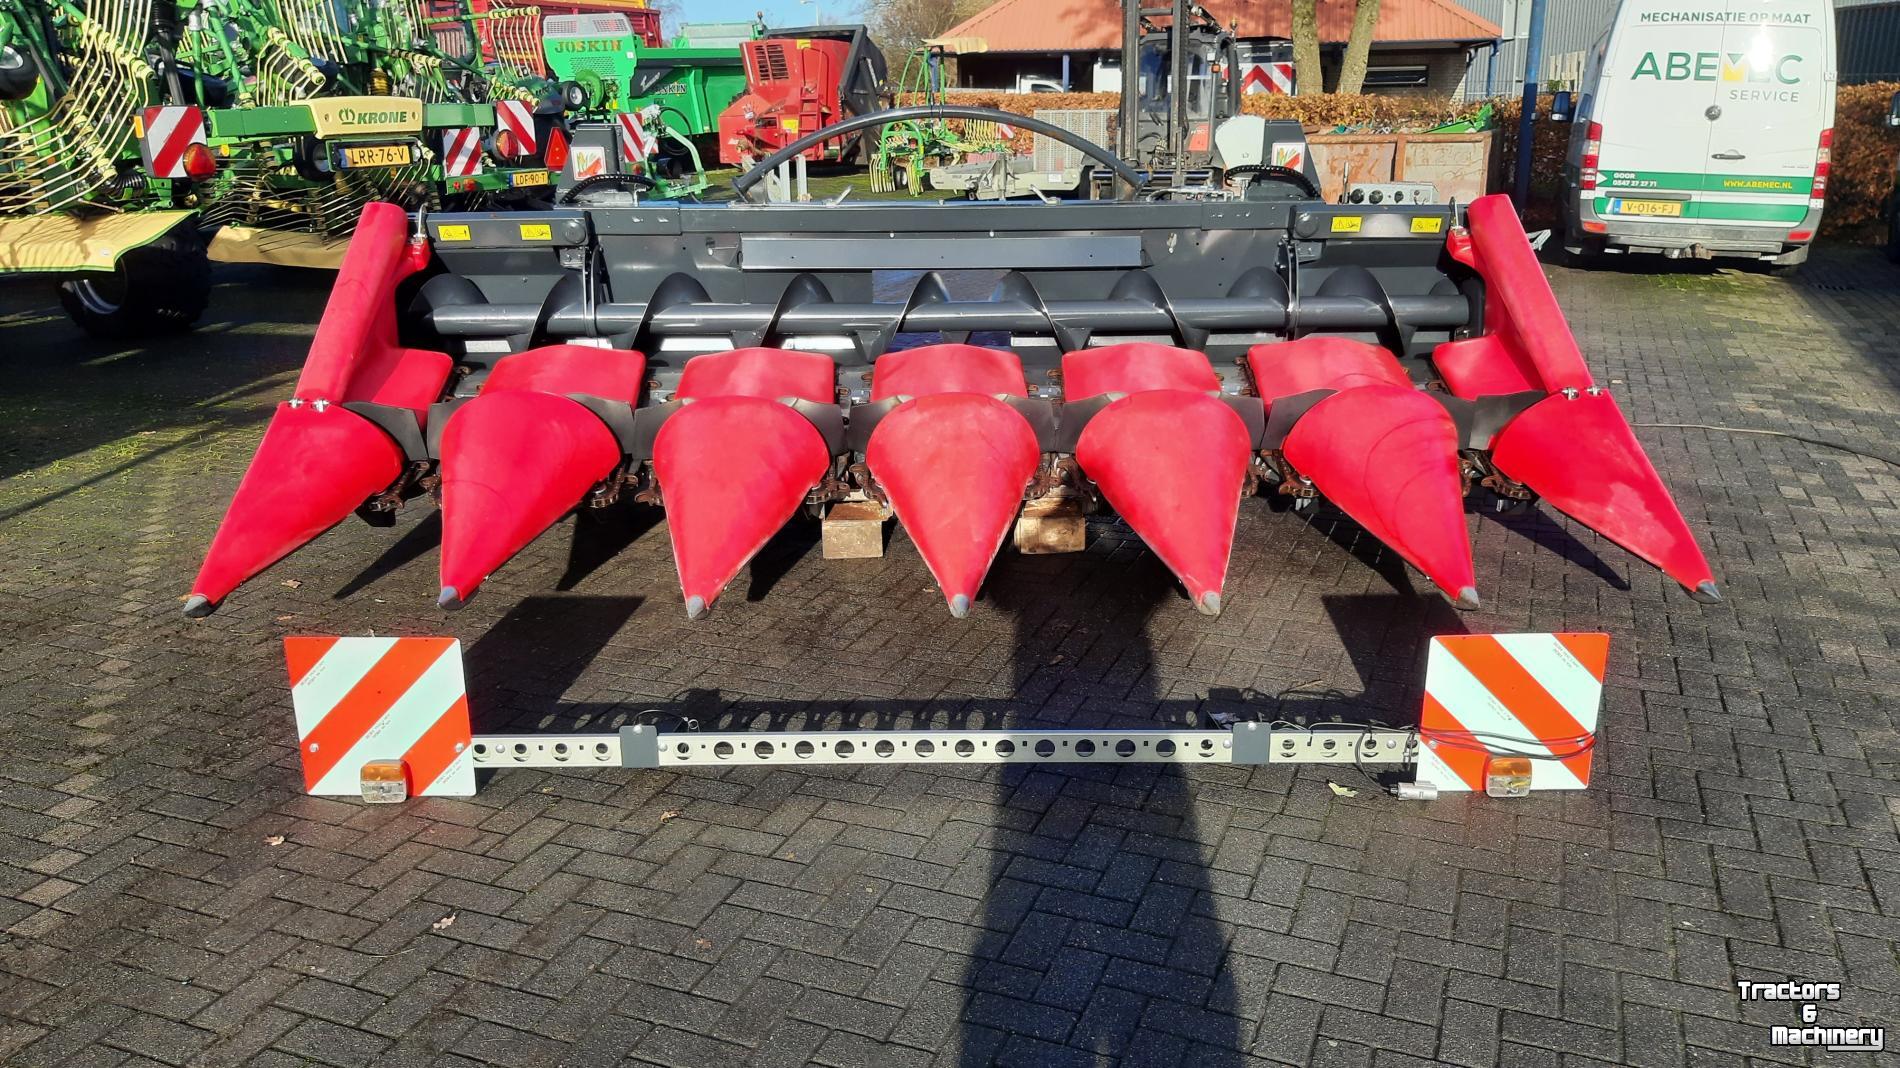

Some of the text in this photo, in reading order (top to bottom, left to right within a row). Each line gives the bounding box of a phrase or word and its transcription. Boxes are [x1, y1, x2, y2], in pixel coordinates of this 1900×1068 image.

[1640, 12, 1811, 24] MECHANISATIE OP MAAT
[554, 39, 623, 54] JOSKIN
[1729, 89, 1799, 103] SERVICE
[357, 111, 407, 125] KRONE
[351, 147, 405, 165] LRR-76-V
[1613, 172, 1636, 180] GOOR
[1723, 179, 1793, 190] WWW.ABEMEC.NL
[1626, 202, 1674, 214] V-016-FJ
